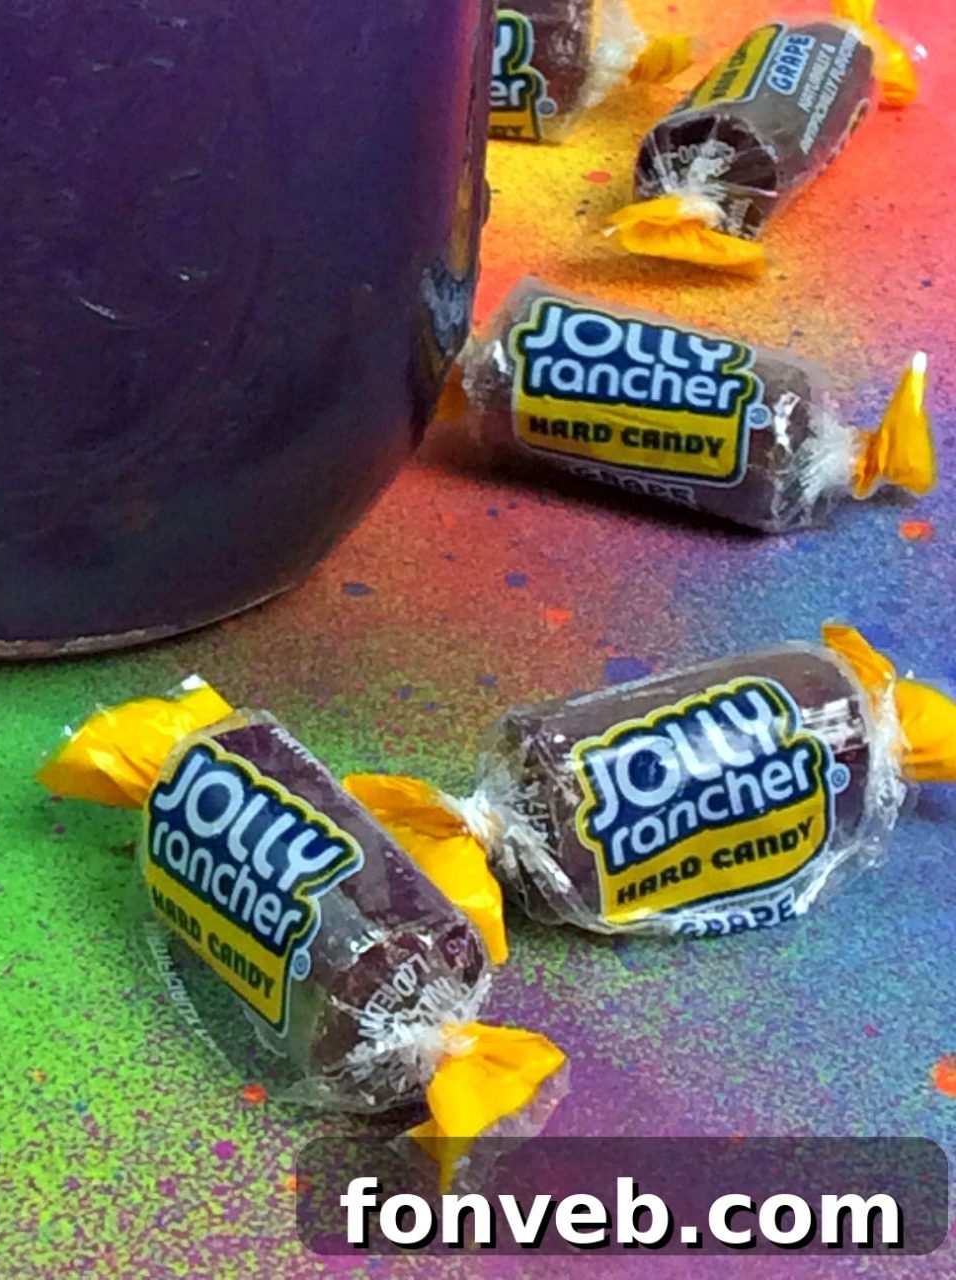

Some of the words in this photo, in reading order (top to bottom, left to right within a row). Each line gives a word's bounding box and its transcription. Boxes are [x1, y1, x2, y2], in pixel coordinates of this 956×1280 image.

[770, 35, 814, 93] GRAPE
[525, 305, 734, 372] JOLLY
[530, 355, 742, 409] rancher
[529, 415, 613, 443] HARD
[621, 426, 726, 458] CANDY
[585, 689, 778, 831] JOLLY
[611, 748, 812, 867] rancher
[154, 752, 346, 890] JOLLY
[616, 855, 701, 905] HARD
[710, 816, 815, 870] CANDY
[152, 820, 302, 947] rancher
[151, 885, 204, 942] HARD
[207, 935, 276, 1000] CANDY
